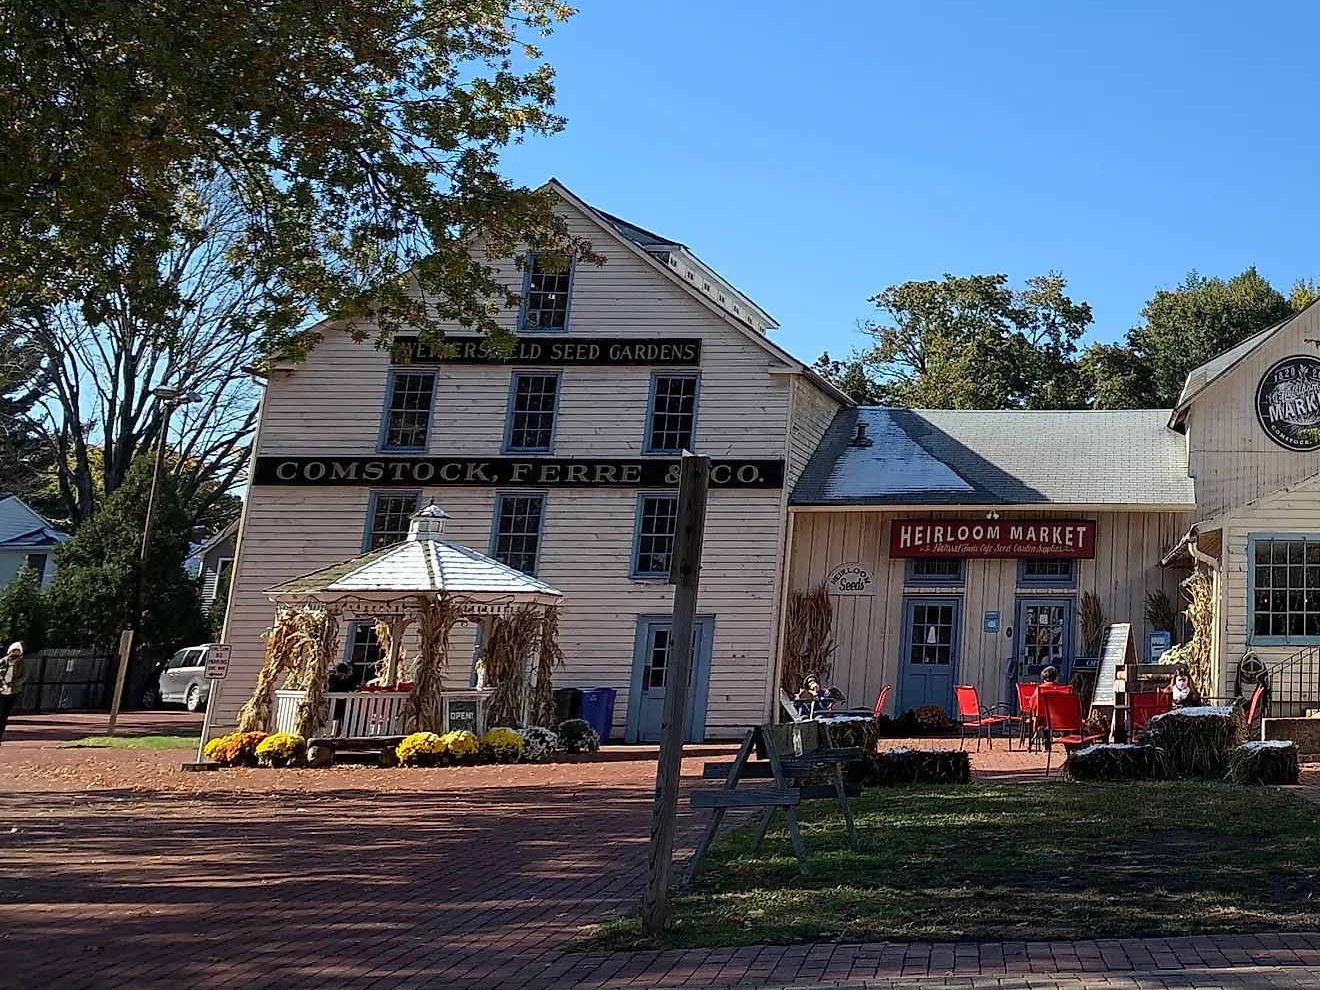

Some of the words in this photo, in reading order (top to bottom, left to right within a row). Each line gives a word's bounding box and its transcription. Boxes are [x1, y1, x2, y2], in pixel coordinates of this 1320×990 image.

[550, 343, 600, 360] SEED
[609, 343, 696, 361] GARDENS
[276, 461, 498, 482] COMSTOCK,
[509, 463, 642, 483] FERRE
[664, 464, 682, 484] &
[709, 464, 764, 484] CO.
[900, 525, 1000, 548] HEIRLOOM
[1010, 526, 1087, 548] MARKET
[830, 567, 871, 585] HEIRLOOM
[839, 577, 865, 591] Seeds
[450, 711, 474, 720] OPEN!
